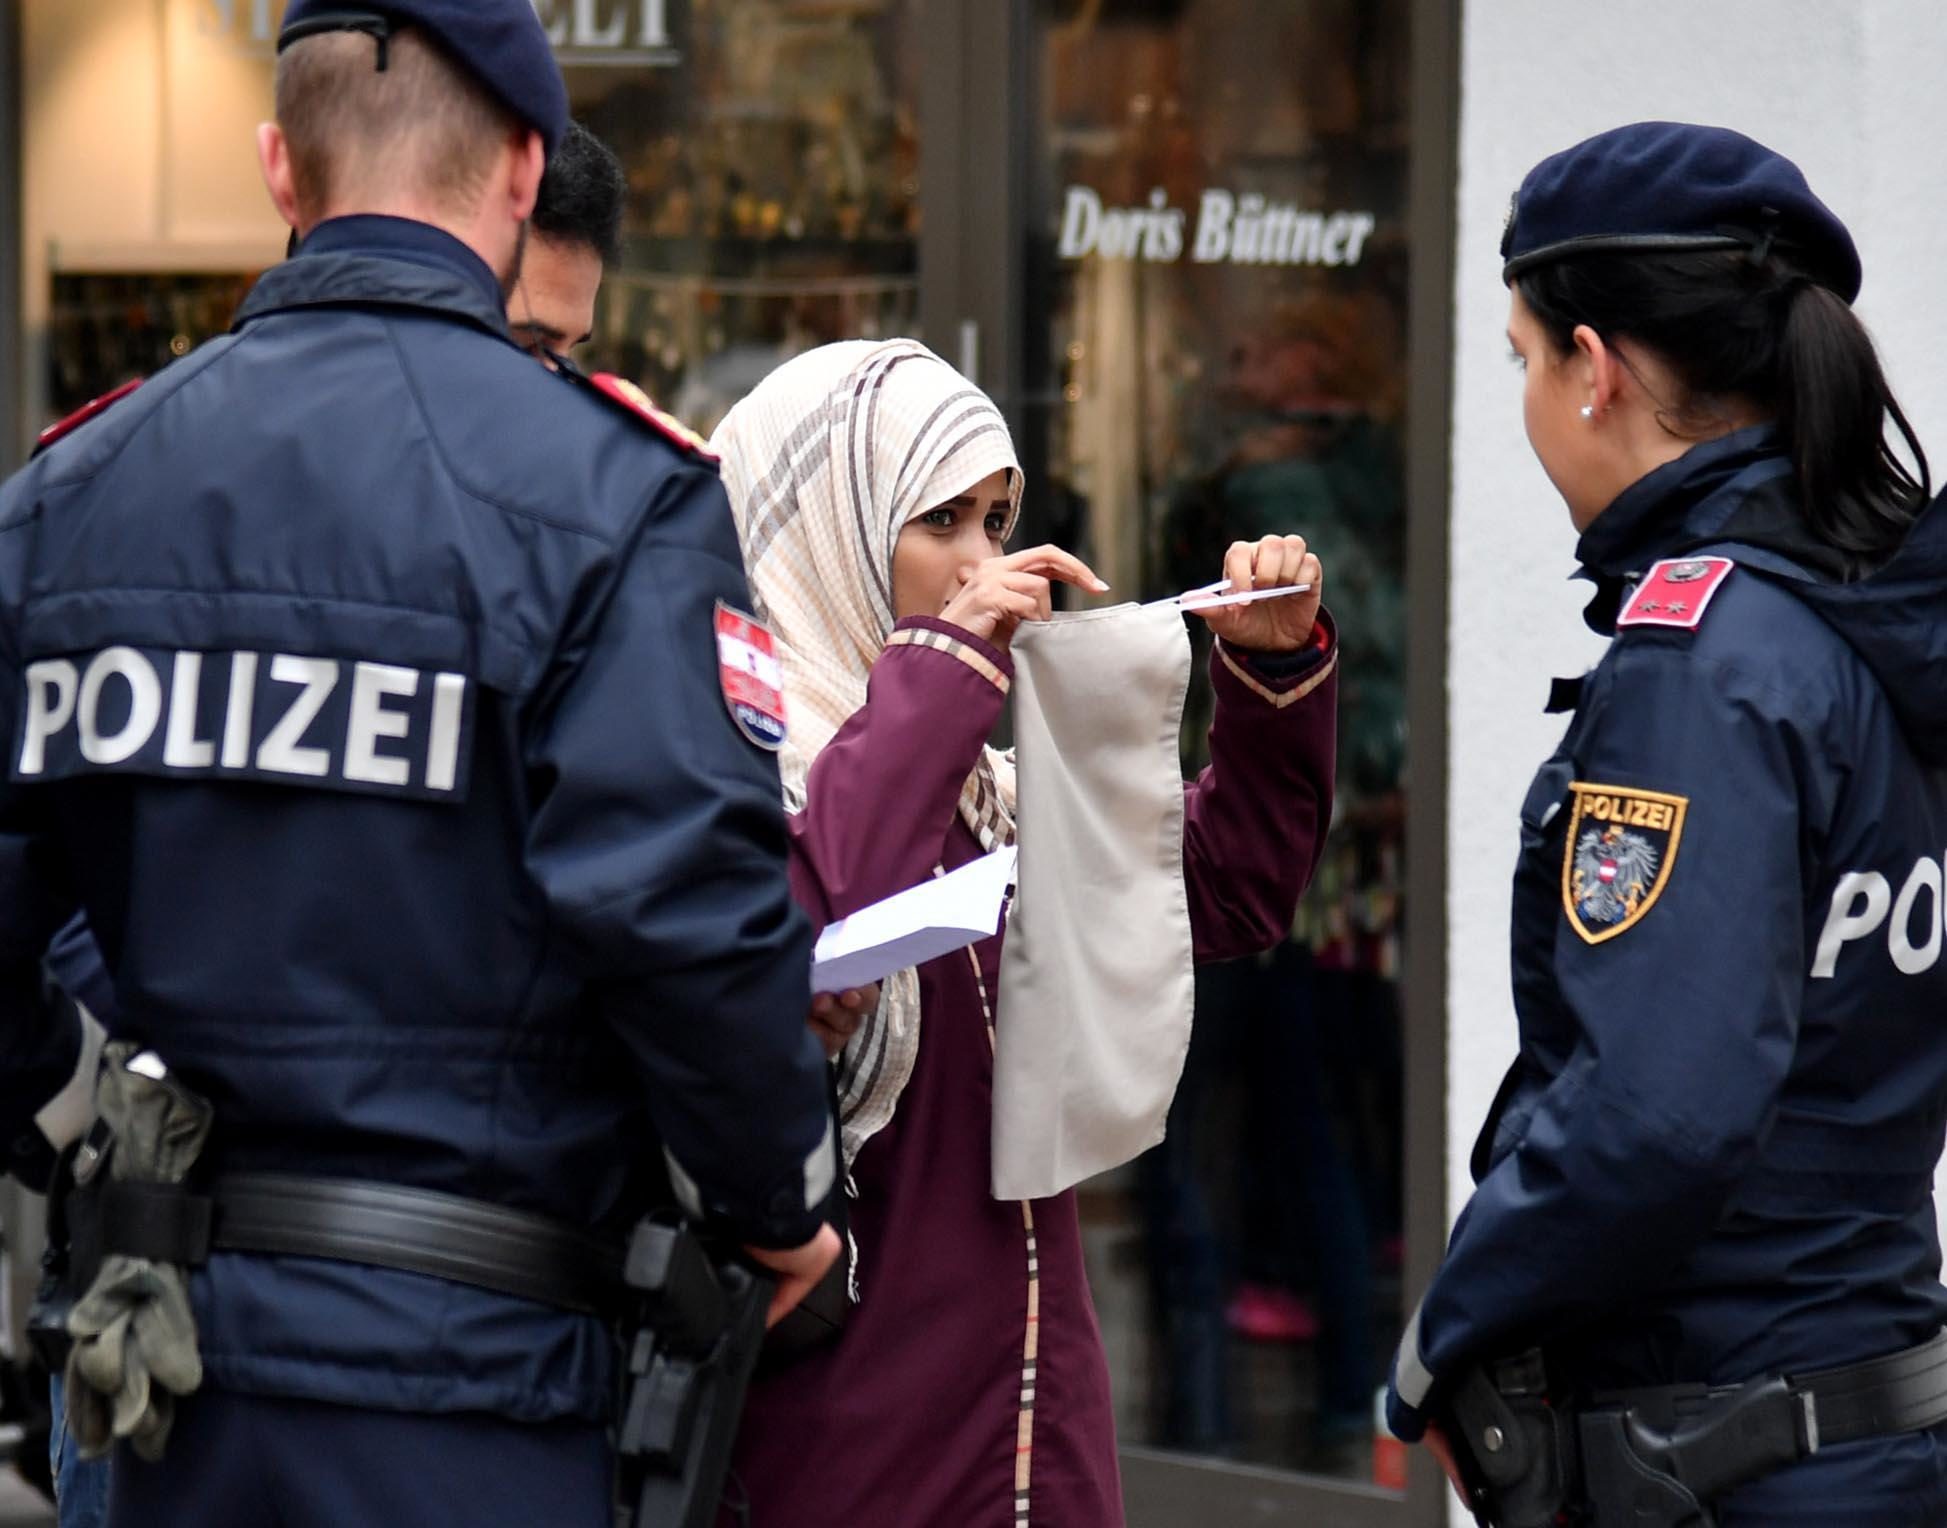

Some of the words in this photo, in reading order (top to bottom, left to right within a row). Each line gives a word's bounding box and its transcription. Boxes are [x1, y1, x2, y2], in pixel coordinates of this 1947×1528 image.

[1060, 187, 1185, 260] Doris
[1195, 188, 1375, 265] Büttner
[19, 646, 466, 791] POLIZEI
[1581, 794, 1674, 831] POLIZEI
[1810, 849, 1947, 978] PO
